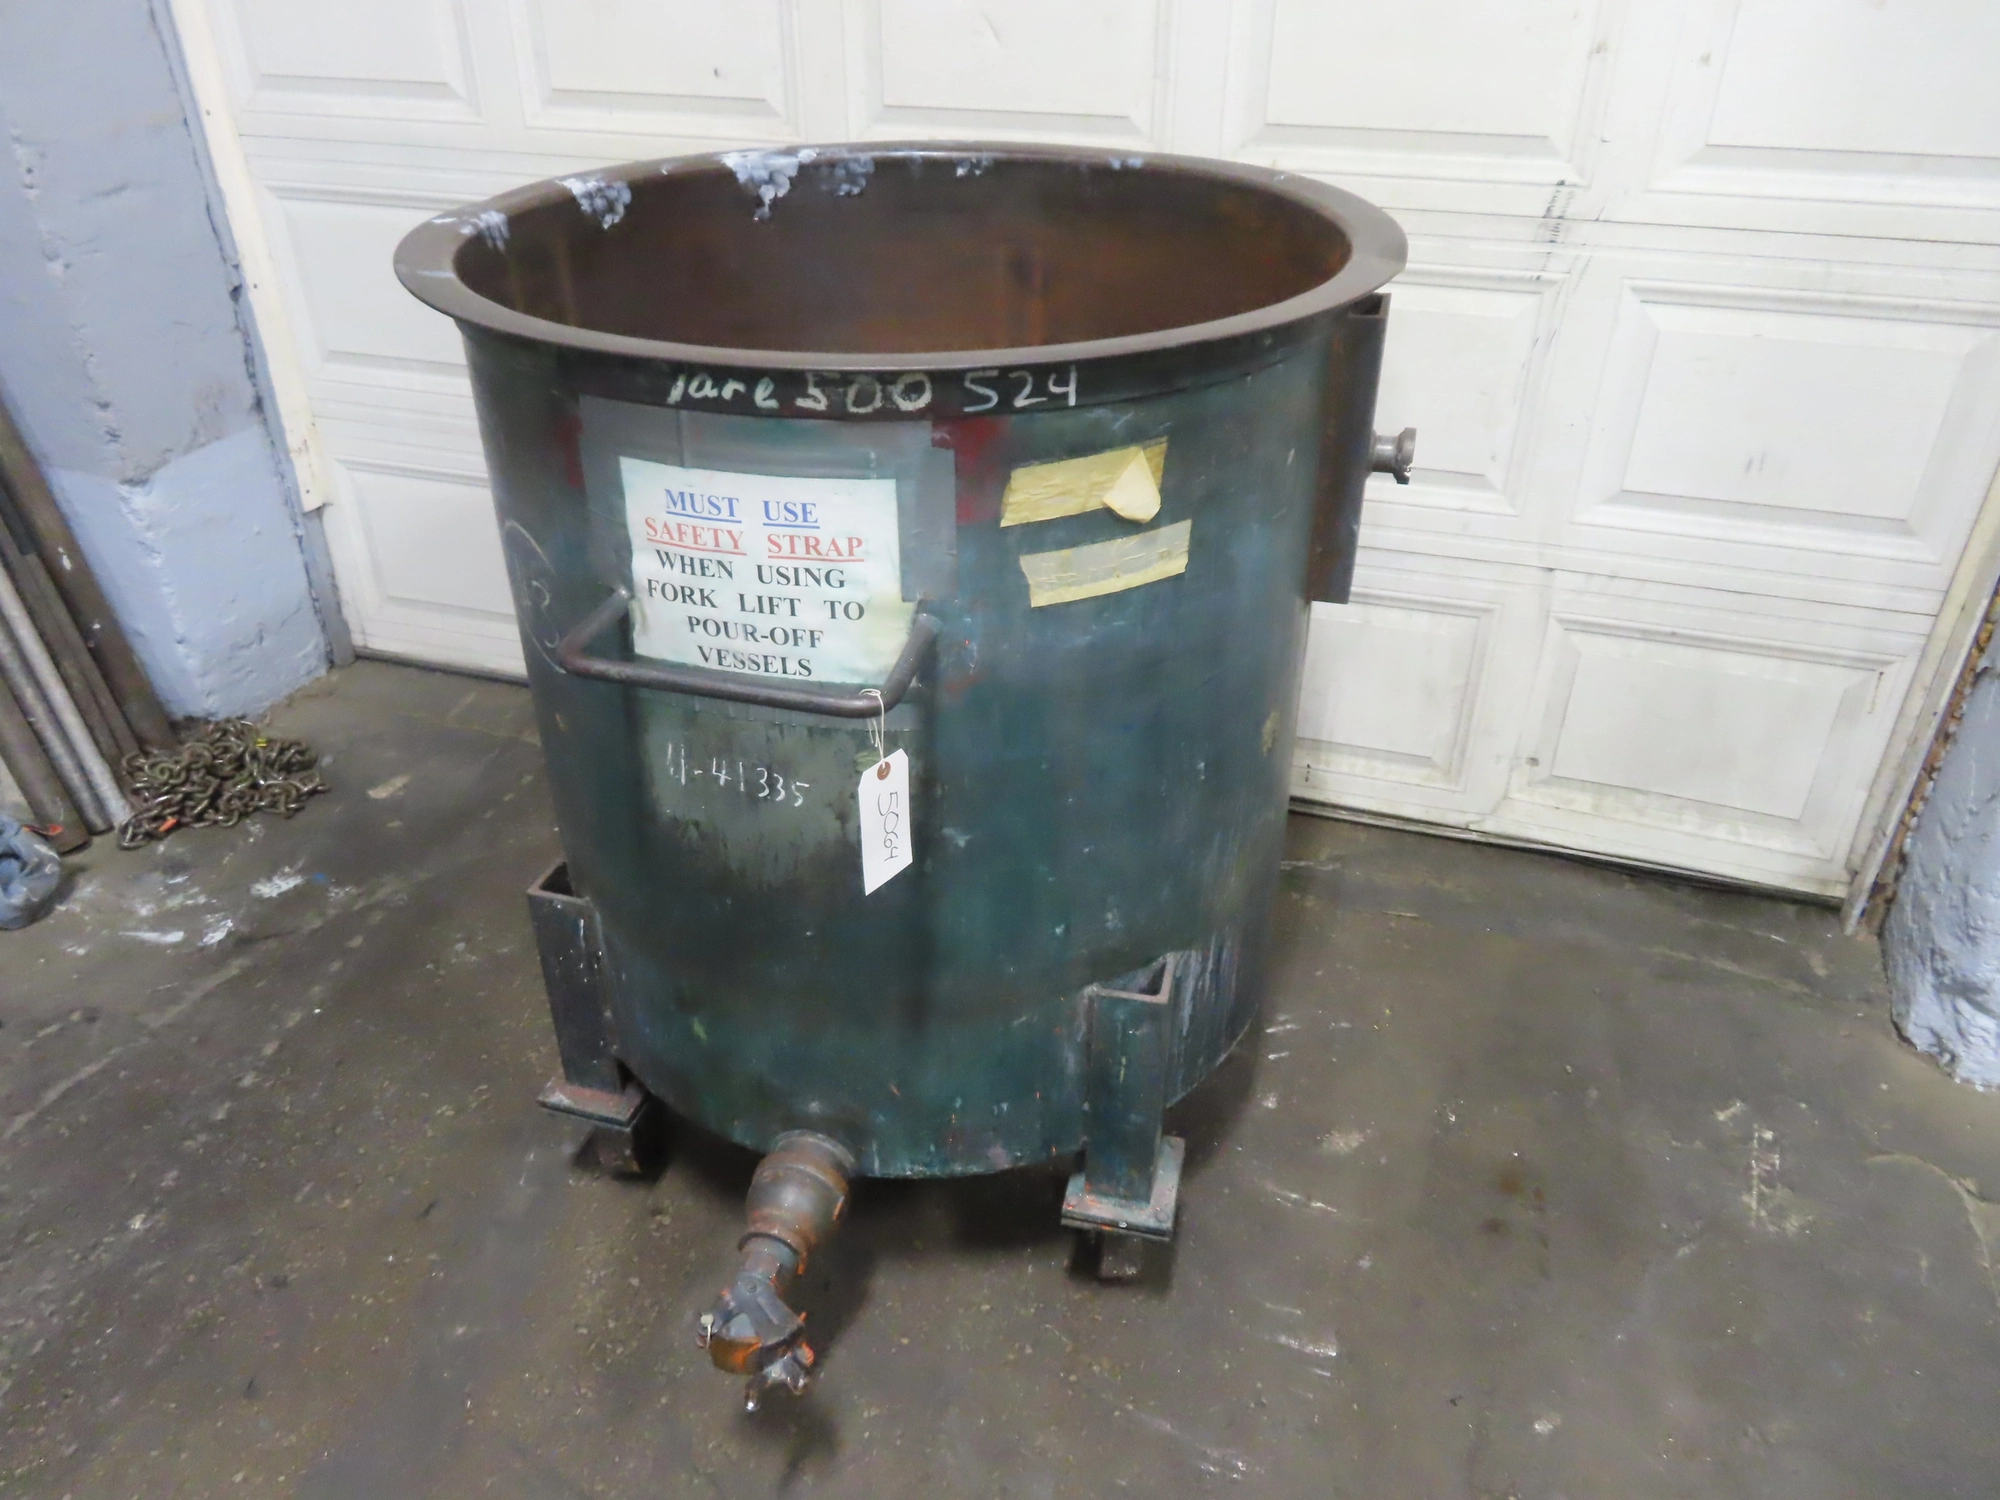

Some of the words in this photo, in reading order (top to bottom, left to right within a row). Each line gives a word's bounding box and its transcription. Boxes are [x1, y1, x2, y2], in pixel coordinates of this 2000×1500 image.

[795, 371, 931, 413] 500
[964, 364, 1077, 412] 524
[664, 488, 740, 518] MUST
[762, 500, 819, 525] USE
[645, 517, 744, 551] SAFETY
[767, 532, 864, 559] STRAP
[655, 549, 734, 580] WHEN
[756, 564, 846, 589] USING
[646, 578, 718, 609] FORK
[738, 593, 801, 617] LIFT
[823, 600, 865, 621] TO
[687, 615, 824, 649] POUR-OFF
[697, 645, 812, 677] VESSELS
[877, 791, 899, 862] 5064
